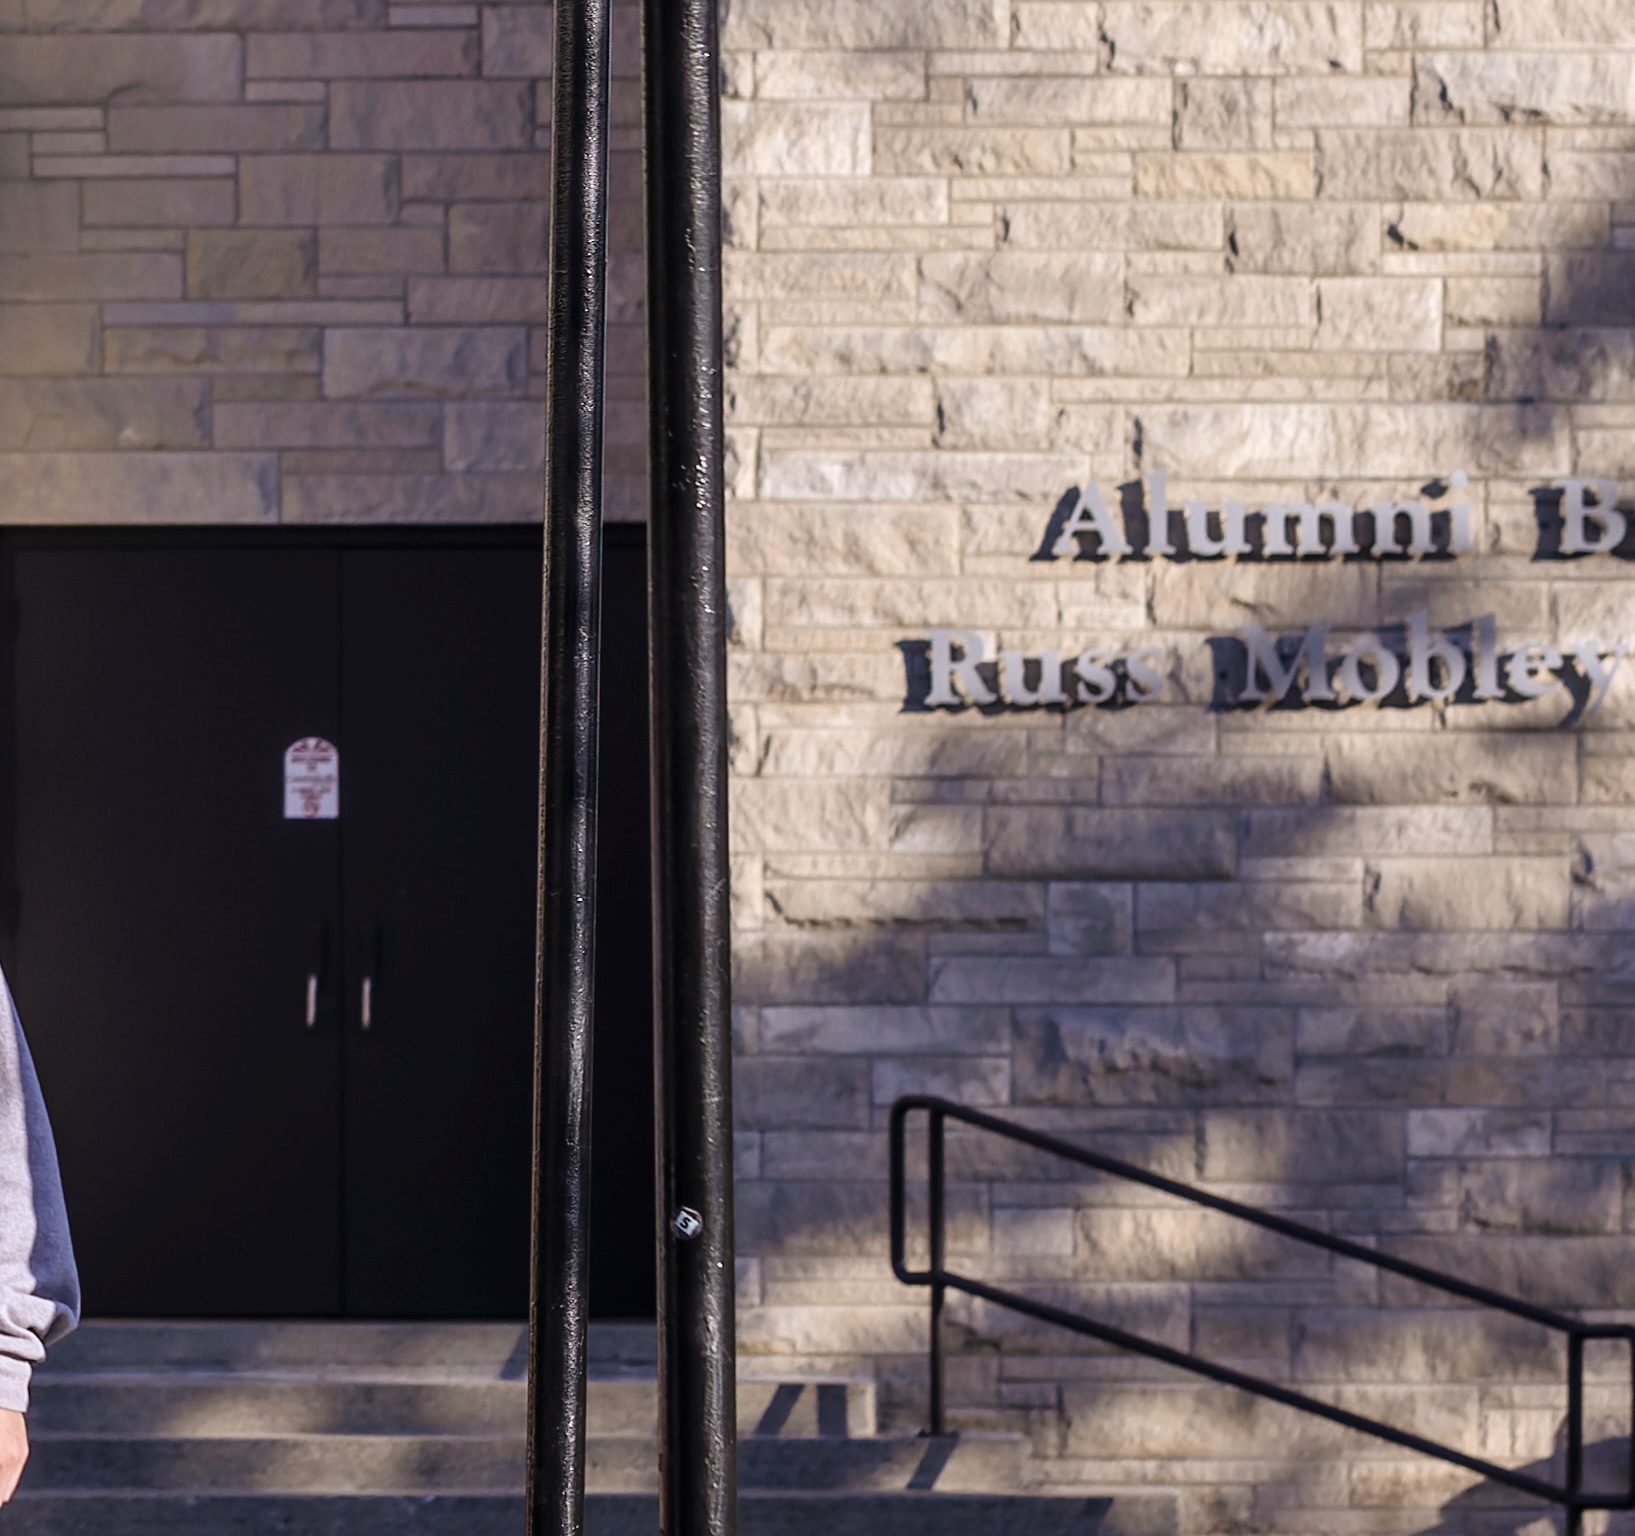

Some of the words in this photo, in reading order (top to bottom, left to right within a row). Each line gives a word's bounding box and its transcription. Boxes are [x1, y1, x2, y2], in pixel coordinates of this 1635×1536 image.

[1052, 468, 1475, 557] Alumni
[924, 629, 1164, 705] Russ
[1239, 610, 1627, 717] Mobley
